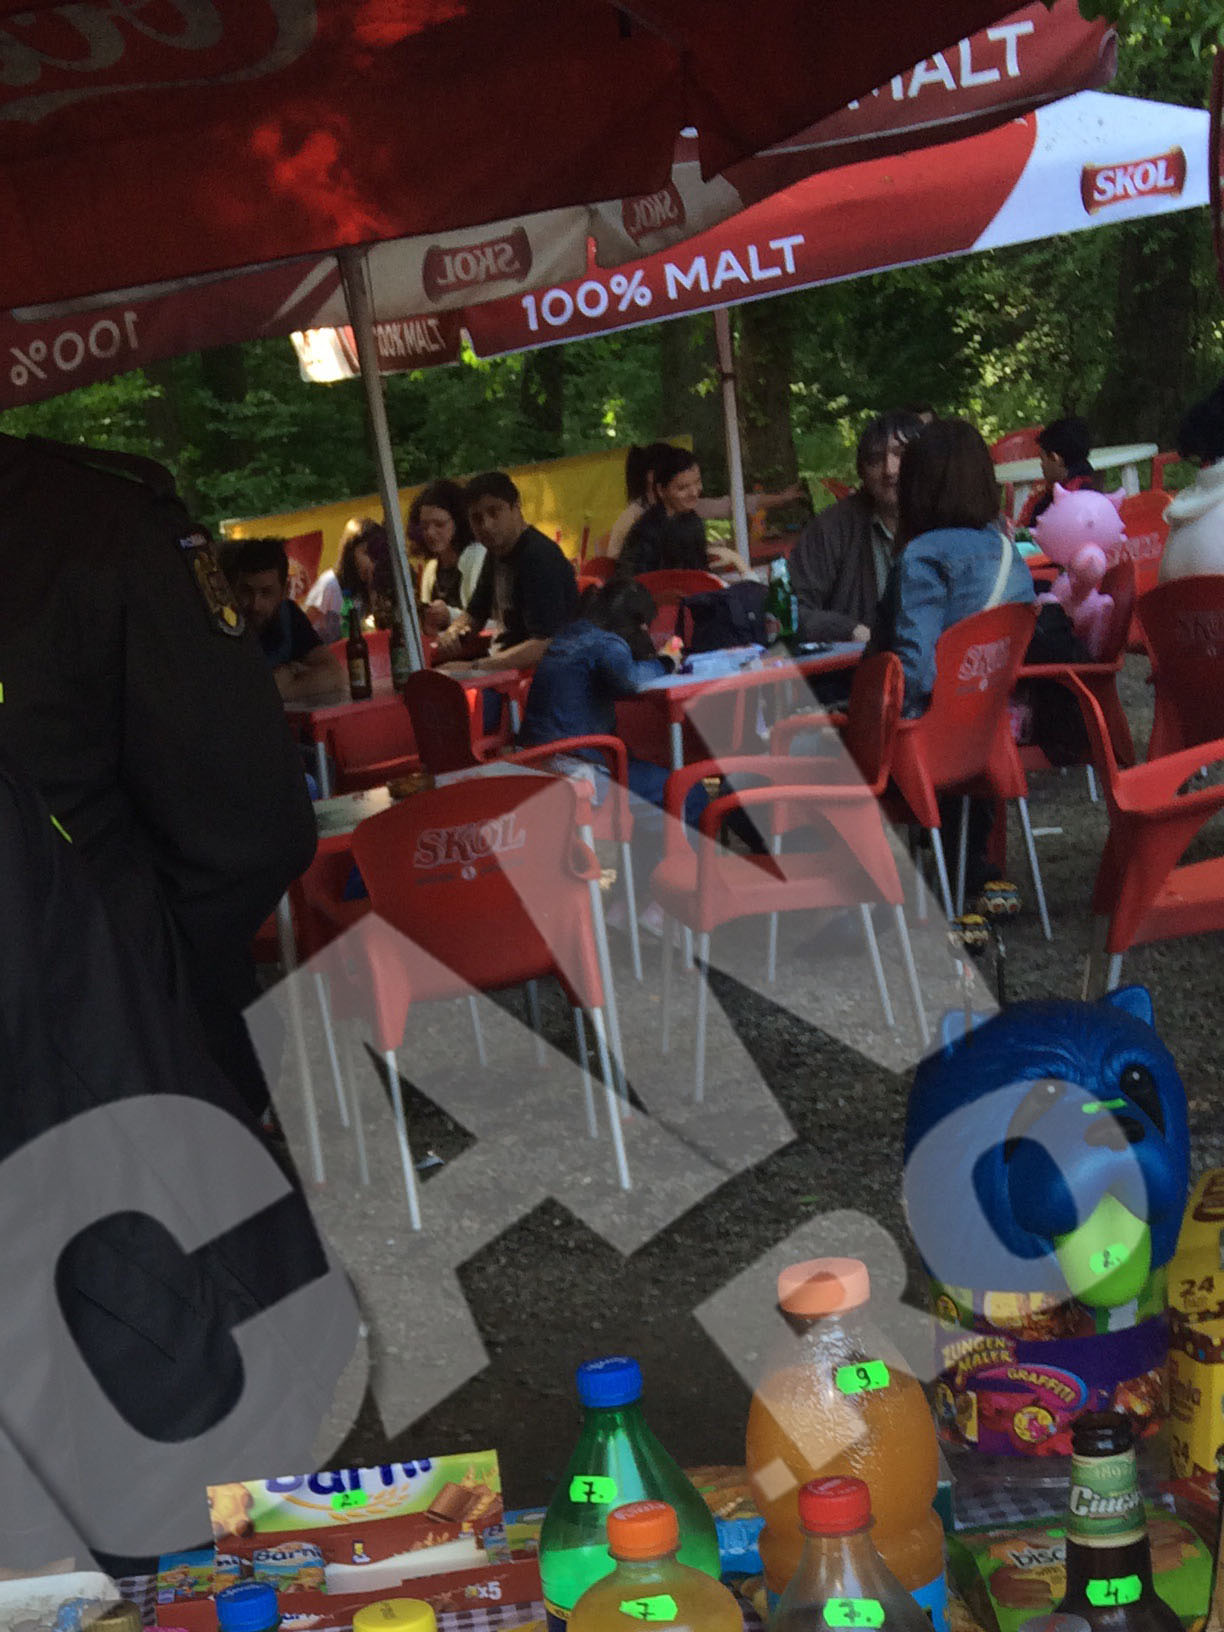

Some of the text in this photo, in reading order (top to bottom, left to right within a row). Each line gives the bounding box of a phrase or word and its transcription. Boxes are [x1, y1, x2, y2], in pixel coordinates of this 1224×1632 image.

[847, 20, 1035, 110] ALT
[1093, 158, 1175, 202] SKOL
[521, 235, 806, 331] 100% MALT
[413, 811, 527, 869] SKOL
